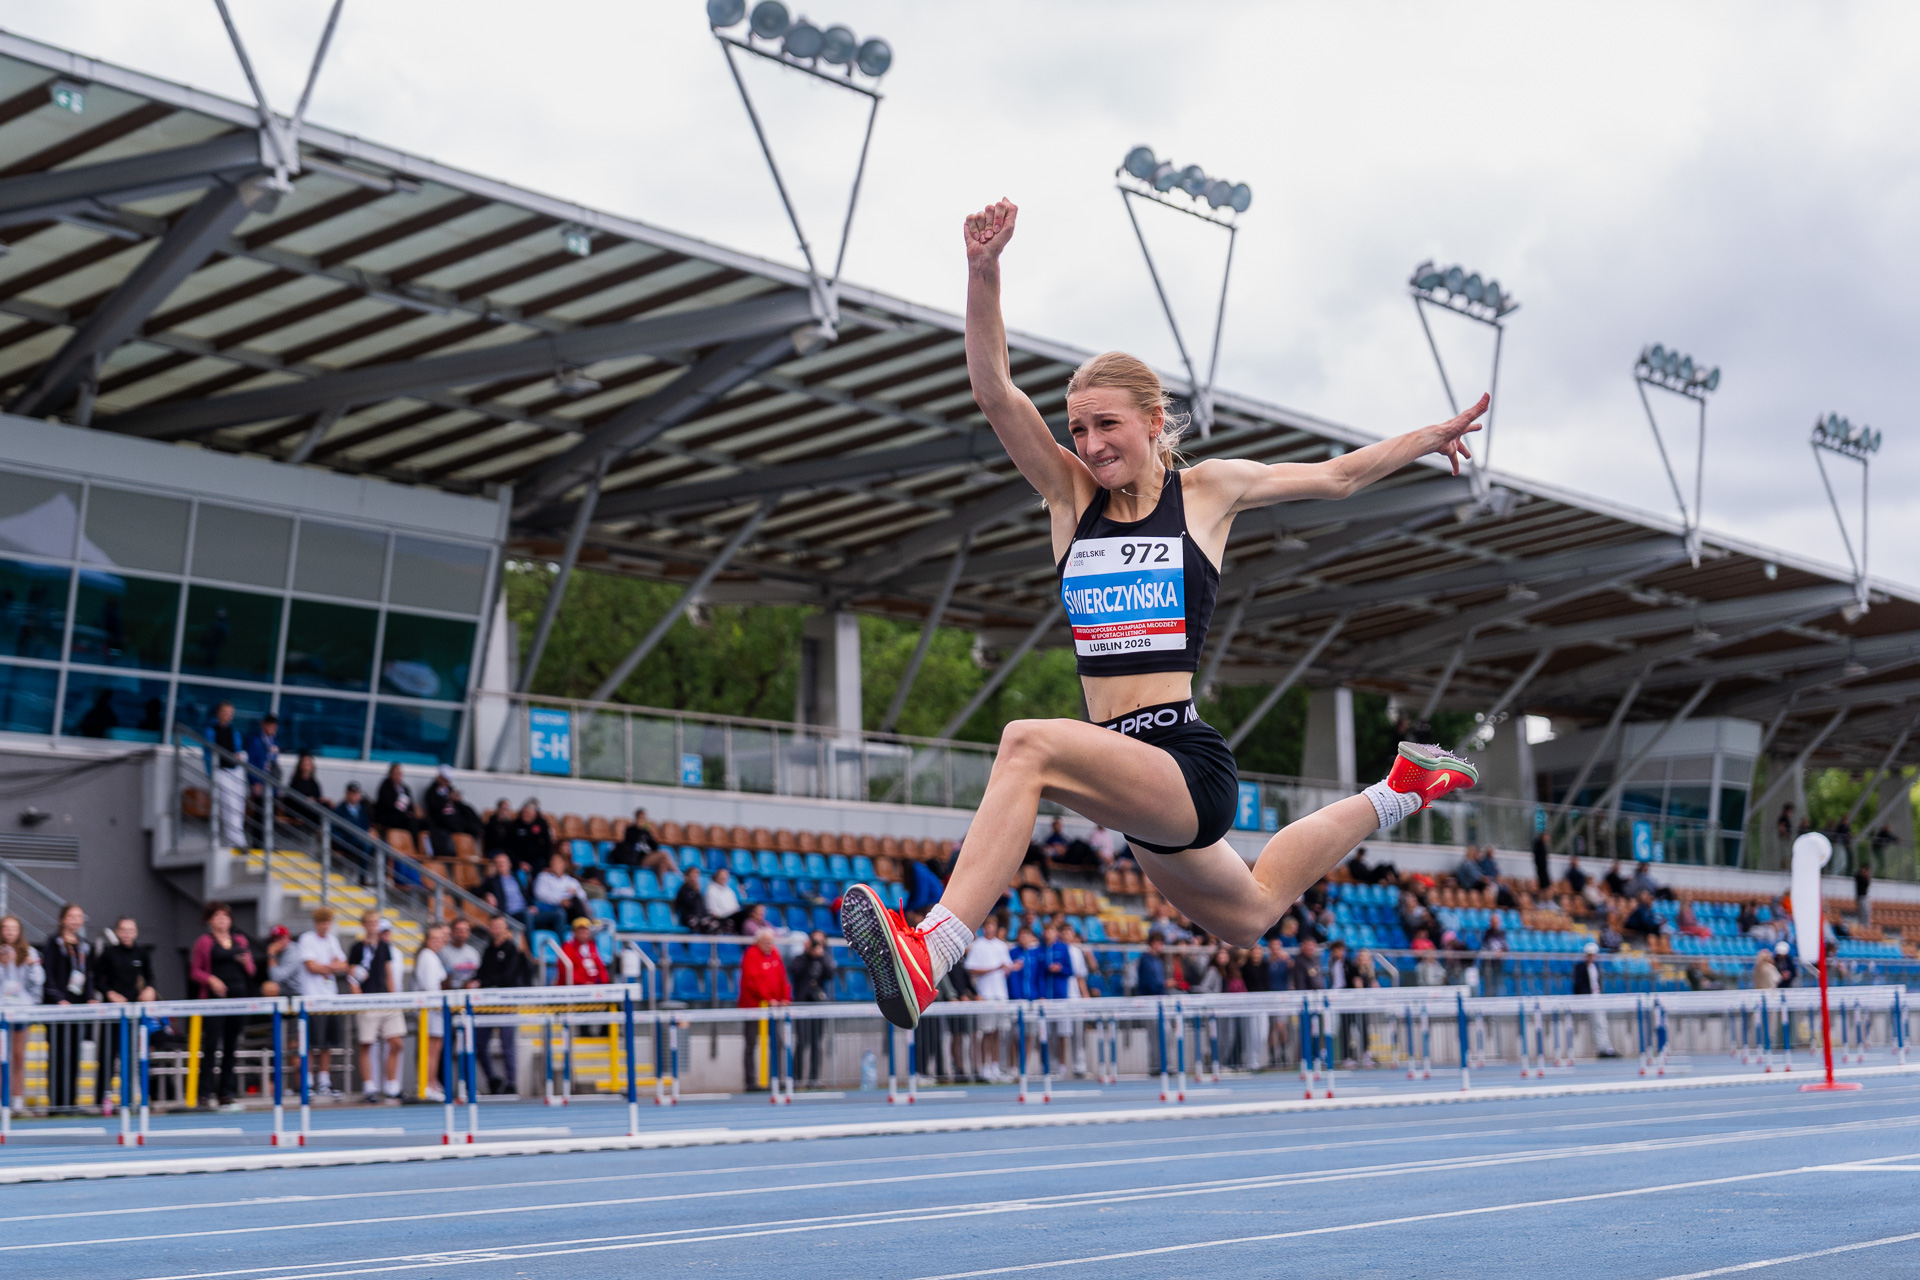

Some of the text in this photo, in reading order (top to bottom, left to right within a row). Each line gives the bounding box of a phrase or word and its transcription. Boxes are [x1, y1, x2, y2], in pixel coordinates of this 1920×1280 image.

[1120, 543, 1170, 565] 972
[1064, 578, 1179, 615] ŚWIERCZYŃSKA
[1117, 623, 1146, 632] OLIMPIADA
[1089, 638, 1151, 652] LUBLIN 2026
[1121, 708, 1178, 734] PRO
